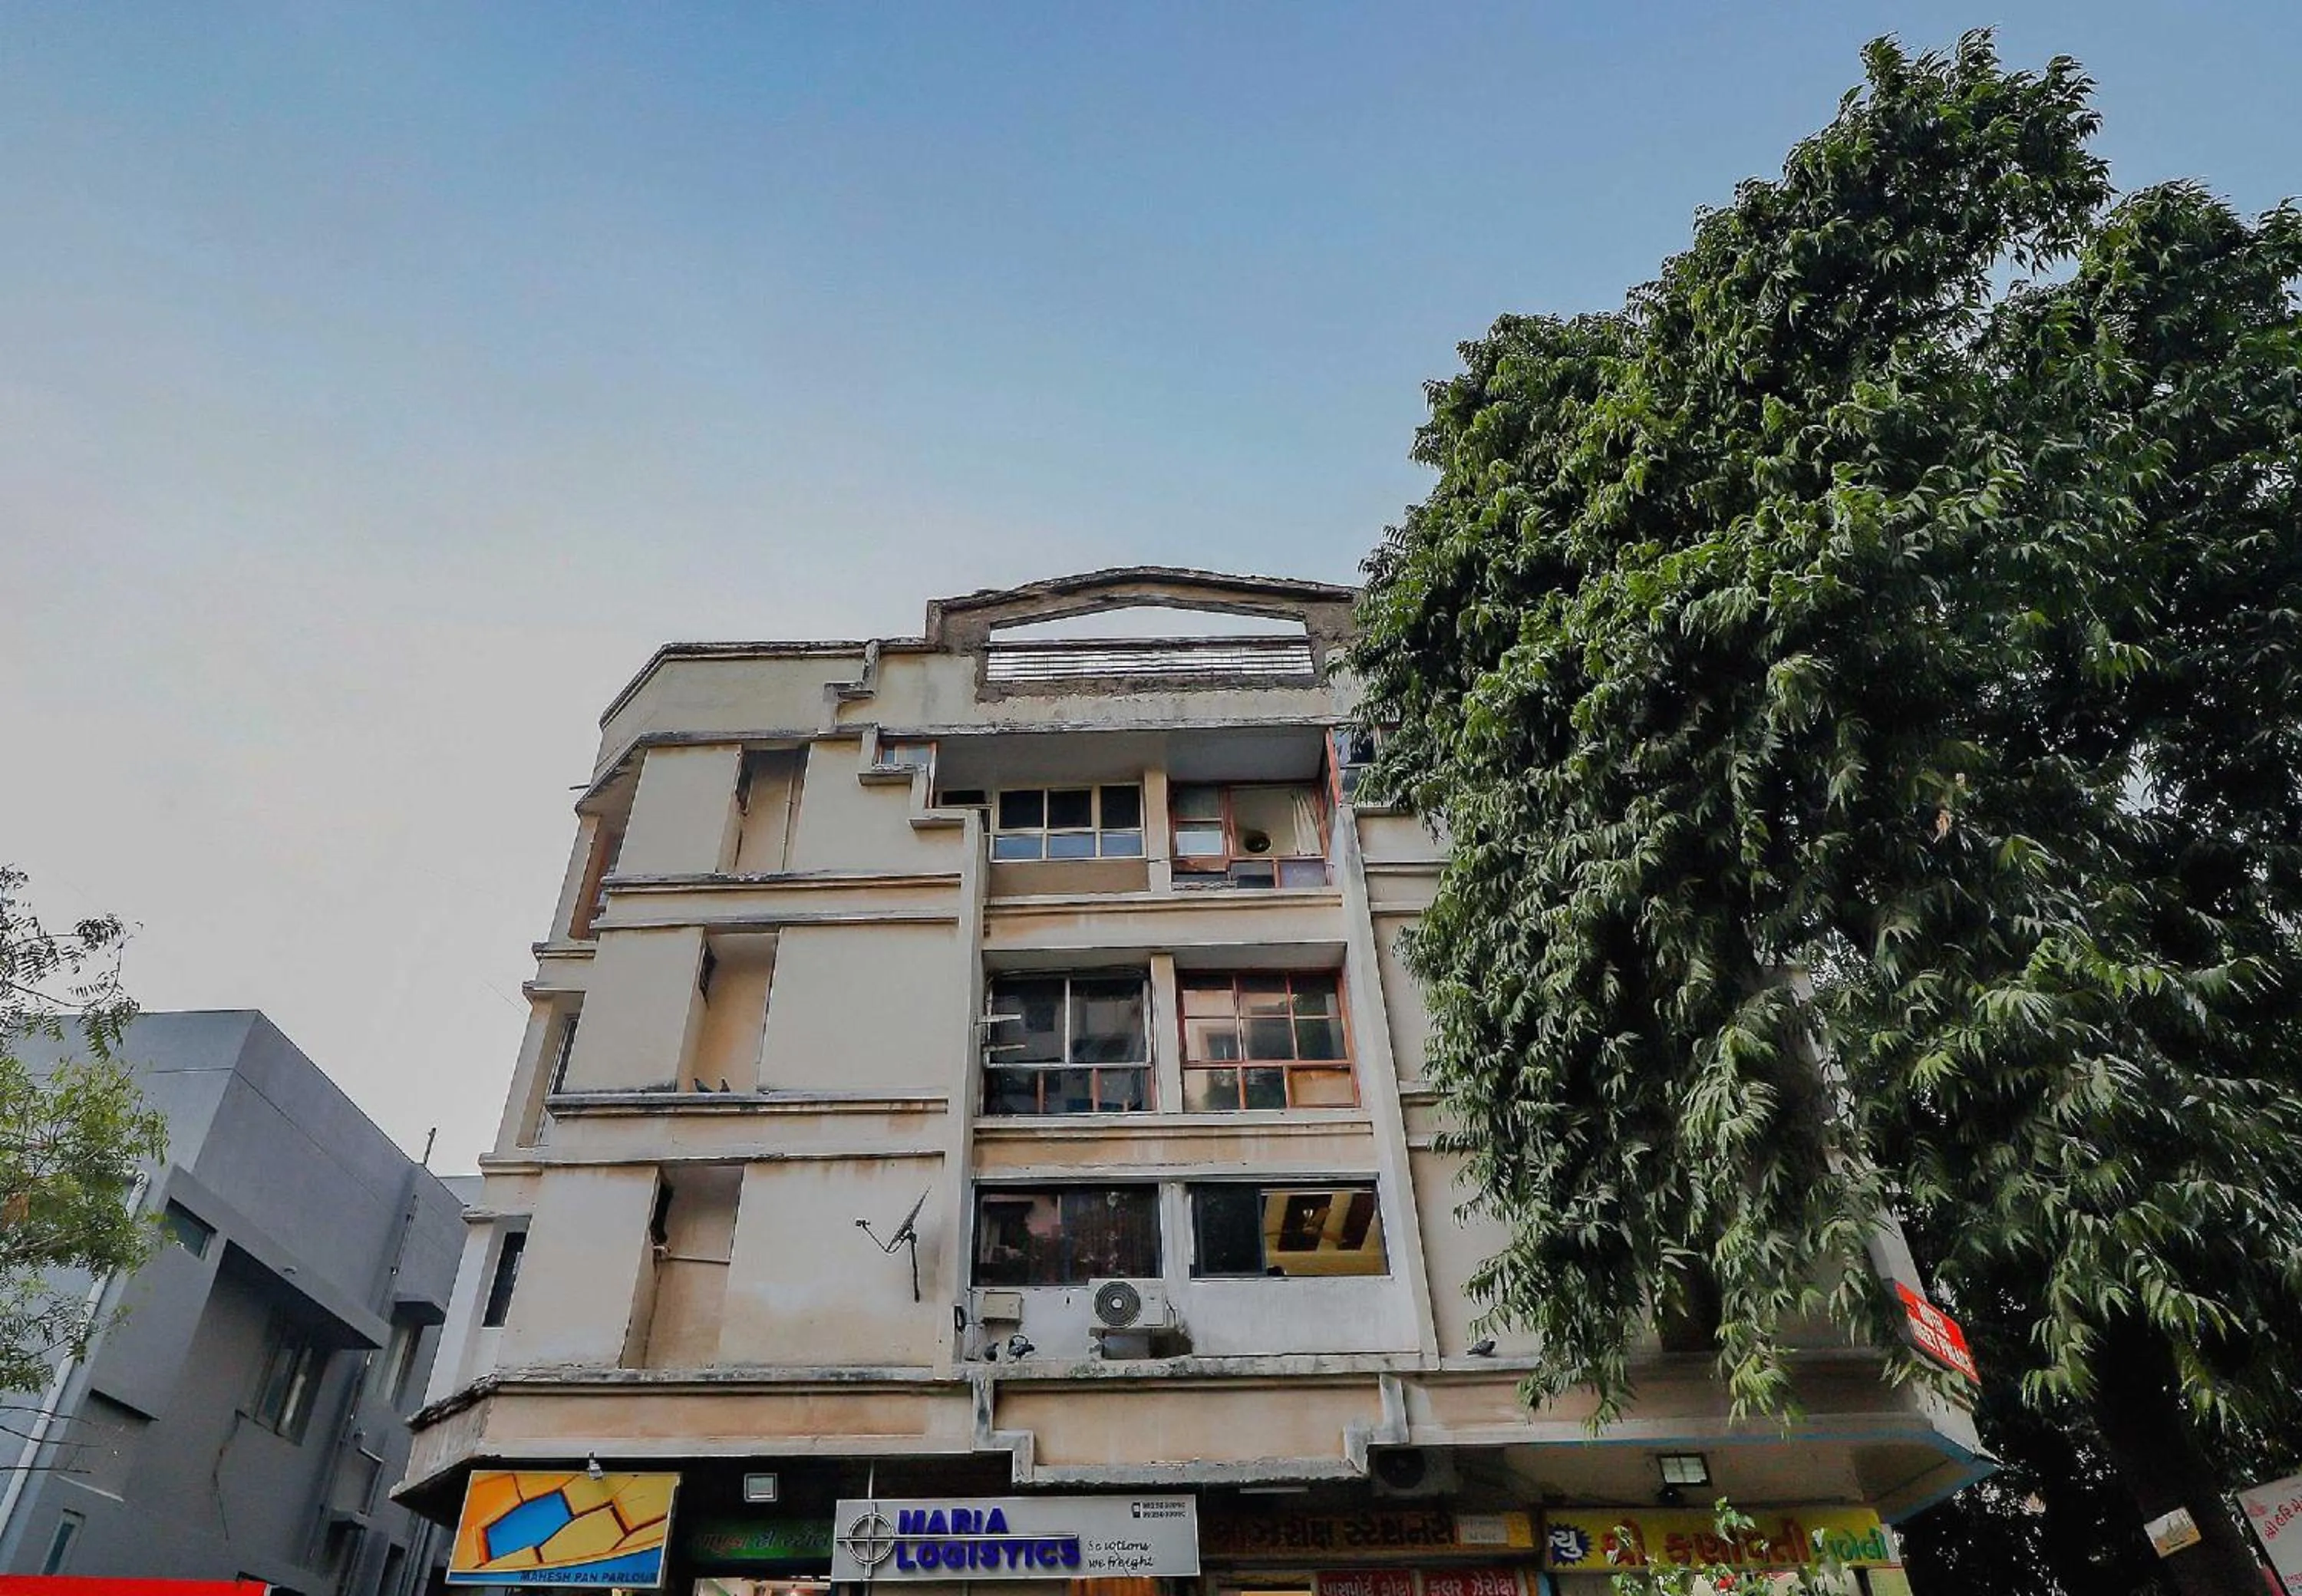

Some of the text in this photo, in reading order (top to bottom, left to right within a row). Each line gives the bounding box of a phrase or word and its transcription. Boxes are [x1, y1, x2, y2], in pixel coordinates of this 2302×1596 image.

[898, 1507, 1009, 1534] MARIA
[895, 1538, 1080, 1570] LOGISTICS
[520, 1571, 658, 1583] MAHESH PAN PARLOUR
